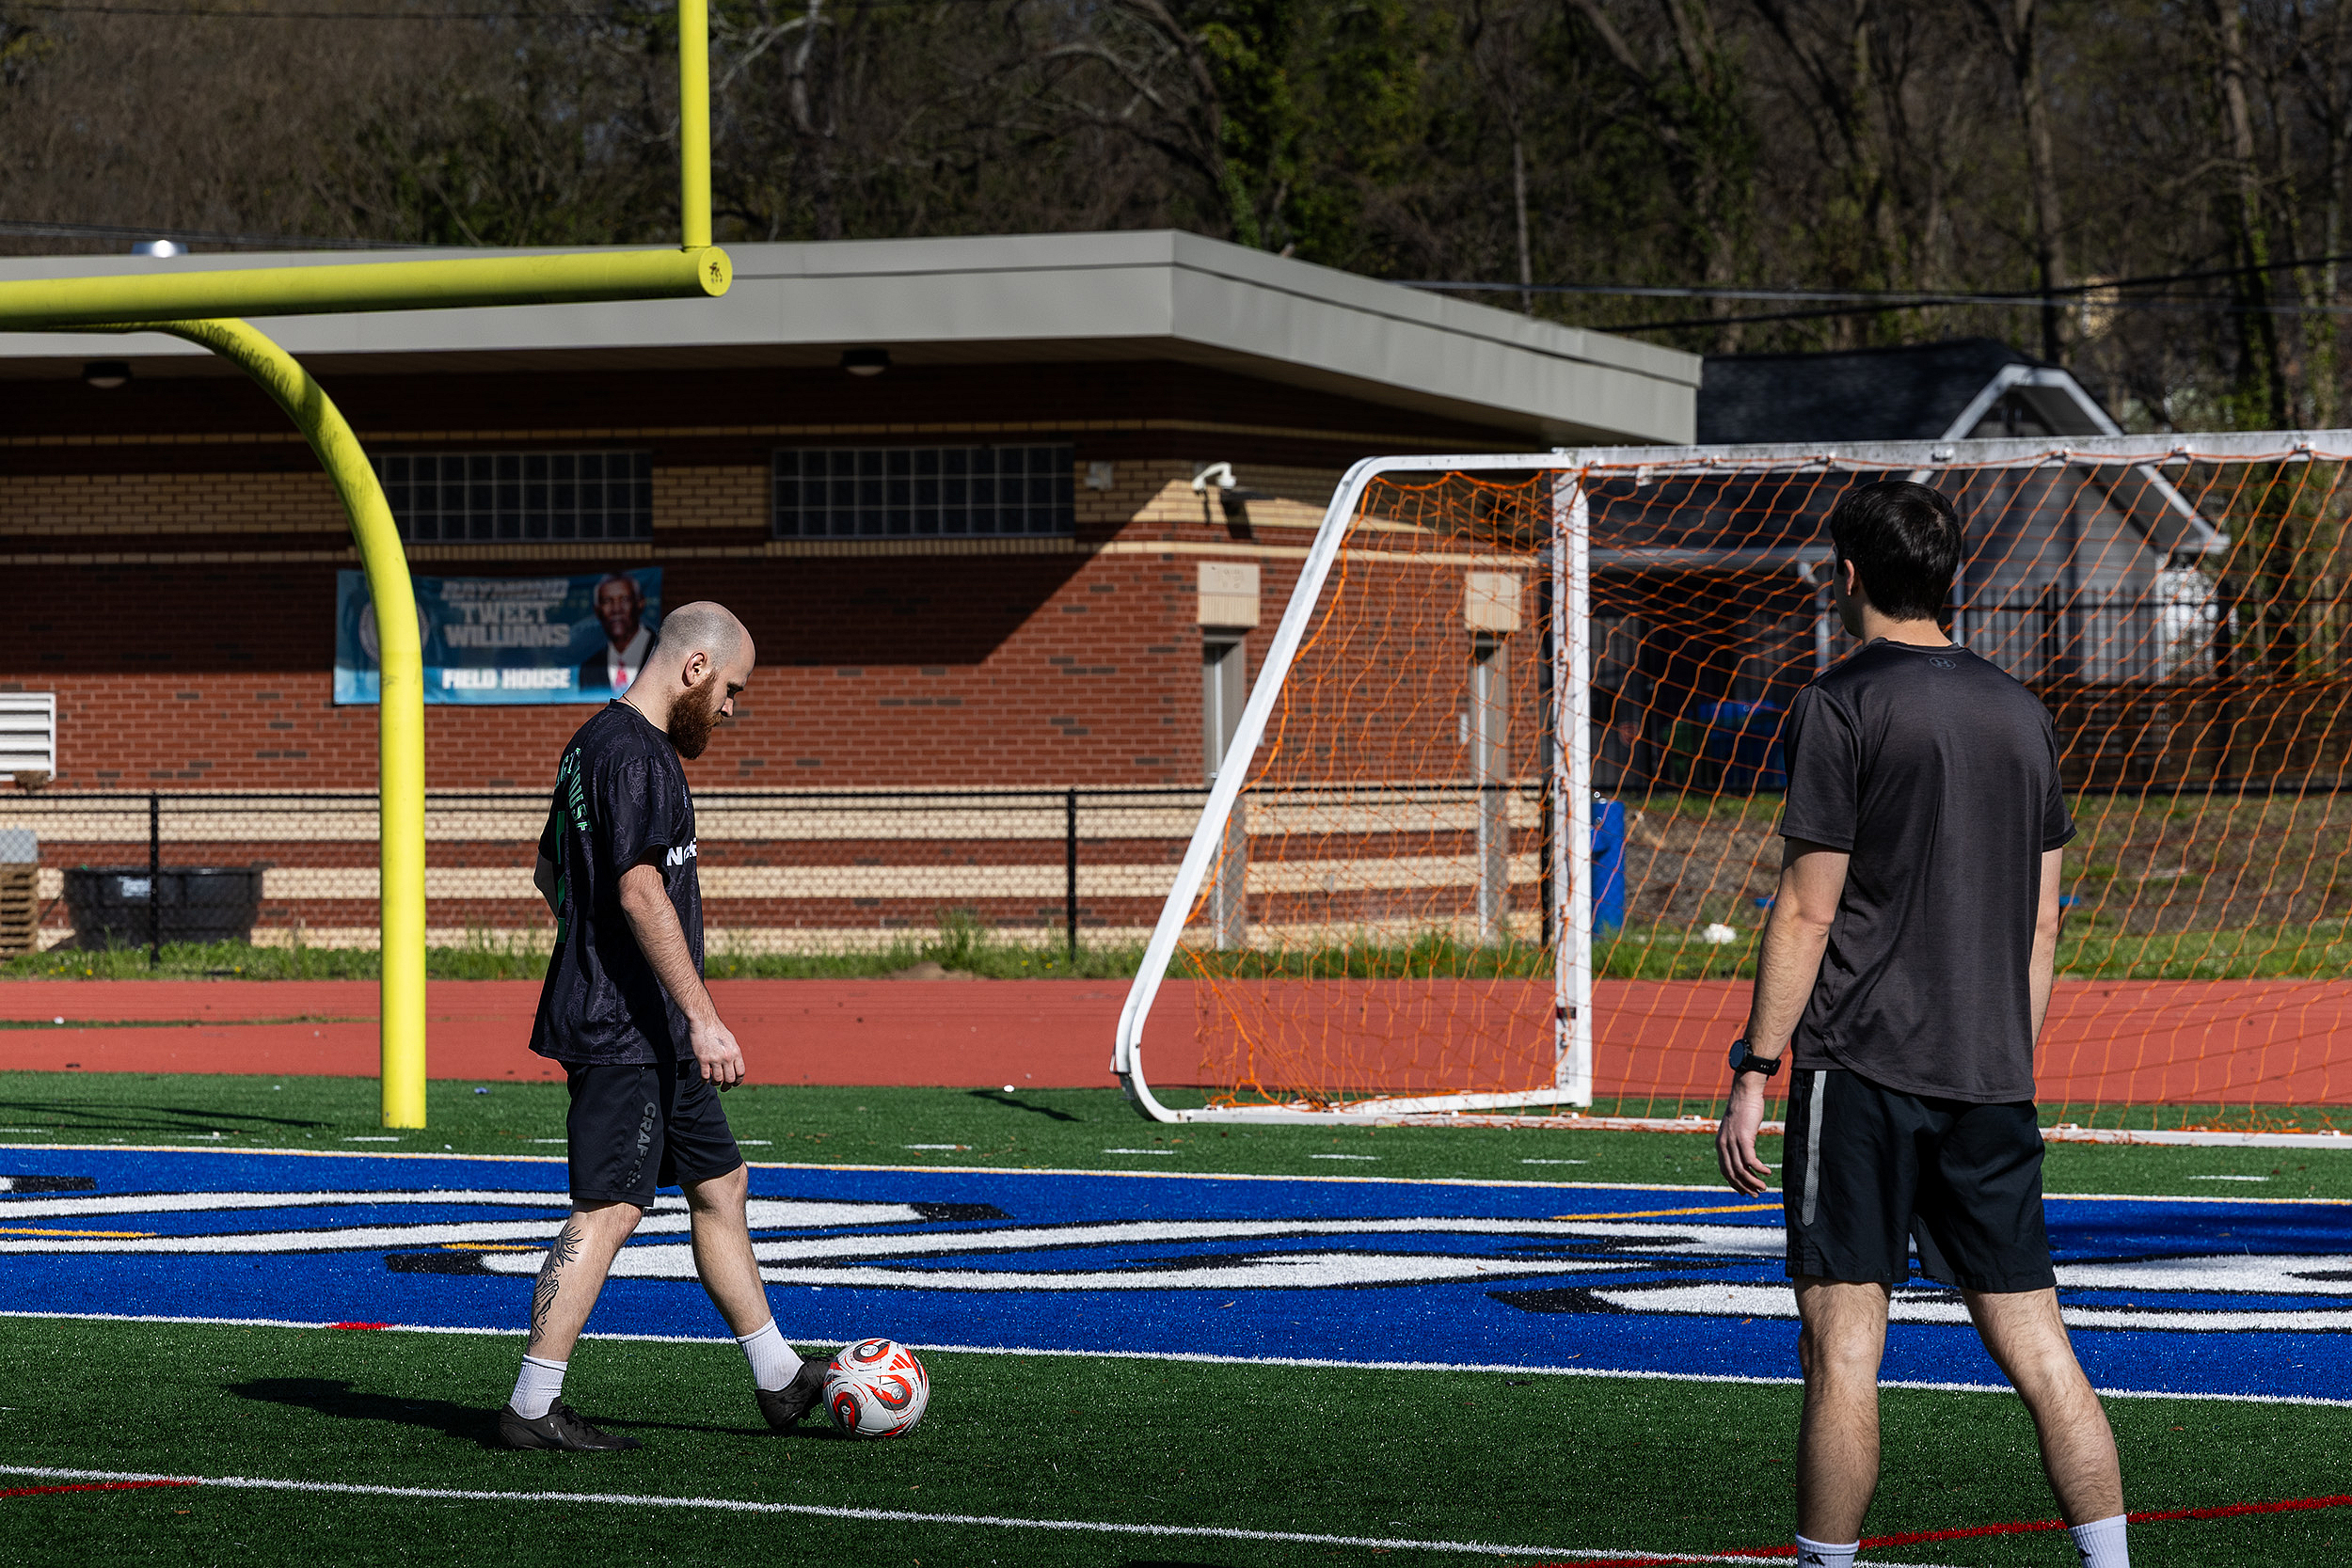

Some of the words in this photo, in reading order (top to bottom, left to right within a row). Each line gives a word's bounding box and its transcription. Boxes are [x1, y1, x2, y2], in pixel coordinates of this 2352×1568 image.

[444, 623, 571, 647] WILLIAMS
[442, 668, 498, 689] FIELD
[501, 668, 571, 689] HOUSE
